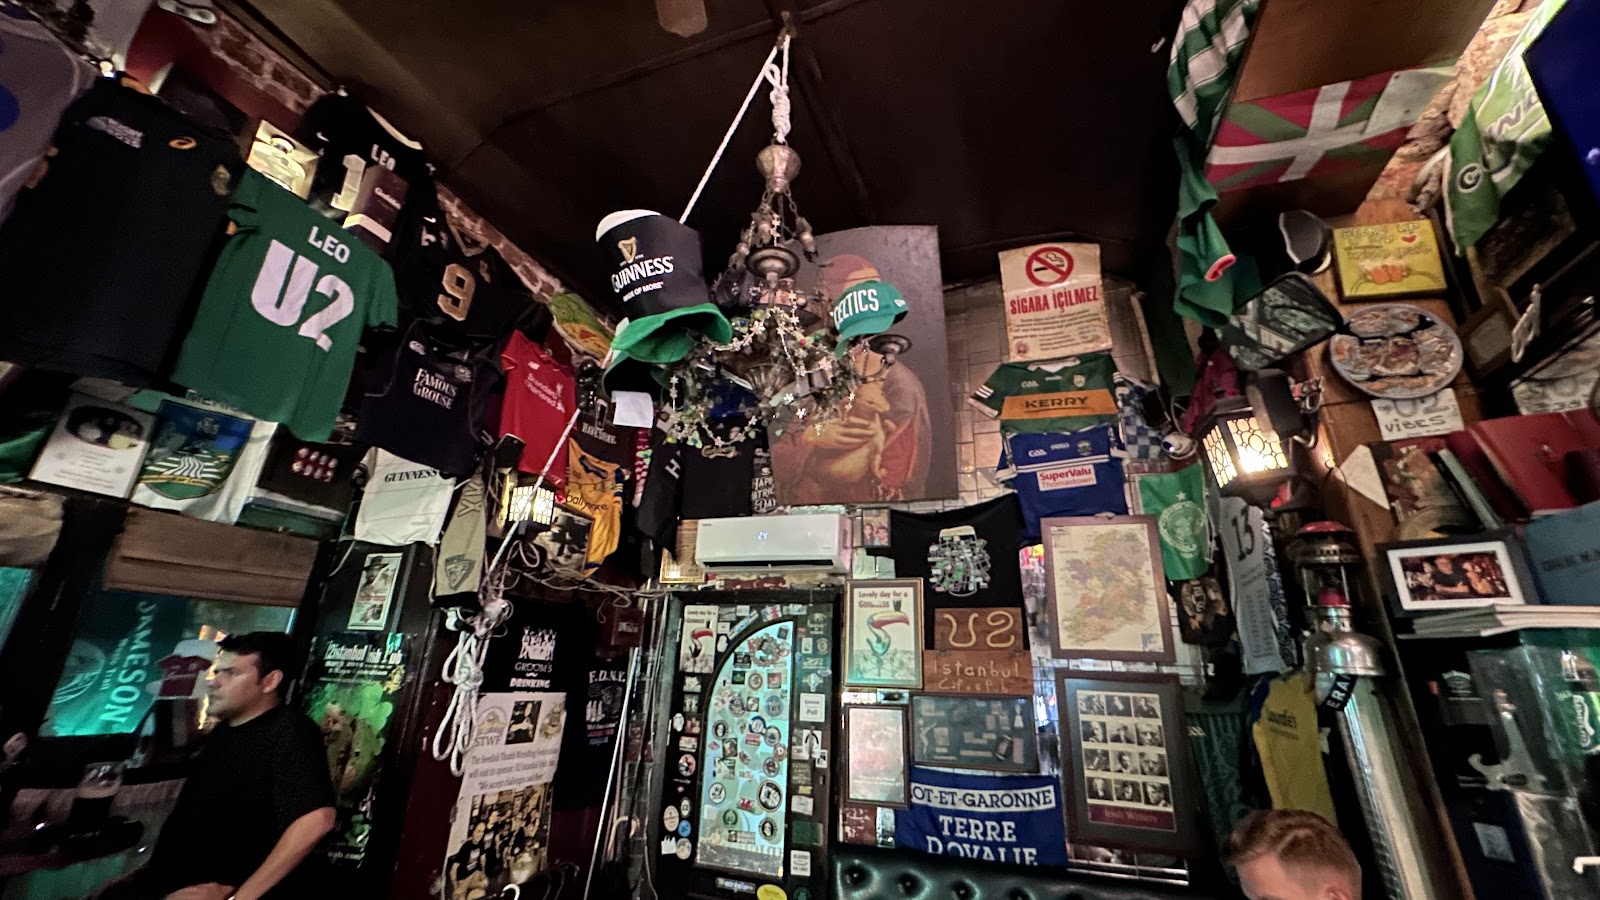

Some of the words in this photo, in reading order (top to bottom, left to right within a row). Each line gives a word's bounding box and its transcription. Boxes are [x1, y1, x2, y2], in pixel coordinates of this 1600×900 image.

[307, 225, 351, 264] LEO
[611, 255, 674, 293] GUINNESS
[250, 238, 355, 351] U2
[437, 263, 476, 322] 9
[833, 288, 880, 331] CELTICS
[412, 381, 454, 410] GROUSE
[414, 367, 458, 398] FAMOUS
[1025, 396, 1089, 410] KERRY
[384, 468, 438, 483] GUINNESS
[1039, 467, 1092, 482] SuperValu
[1041, 477, 1094, 488] Thomastown
[858, 591, 878, 599] Lovely
[879, 590, 891, 598] day
[99, 598, 156, 724] JAMESON
[514, 661, 553, 673] GROOM'S
[934, 660, 1020, 679] Istanbul
[509, 677, 551, 689] DRINKING
[939, 814, 1017, 842] TERRE
